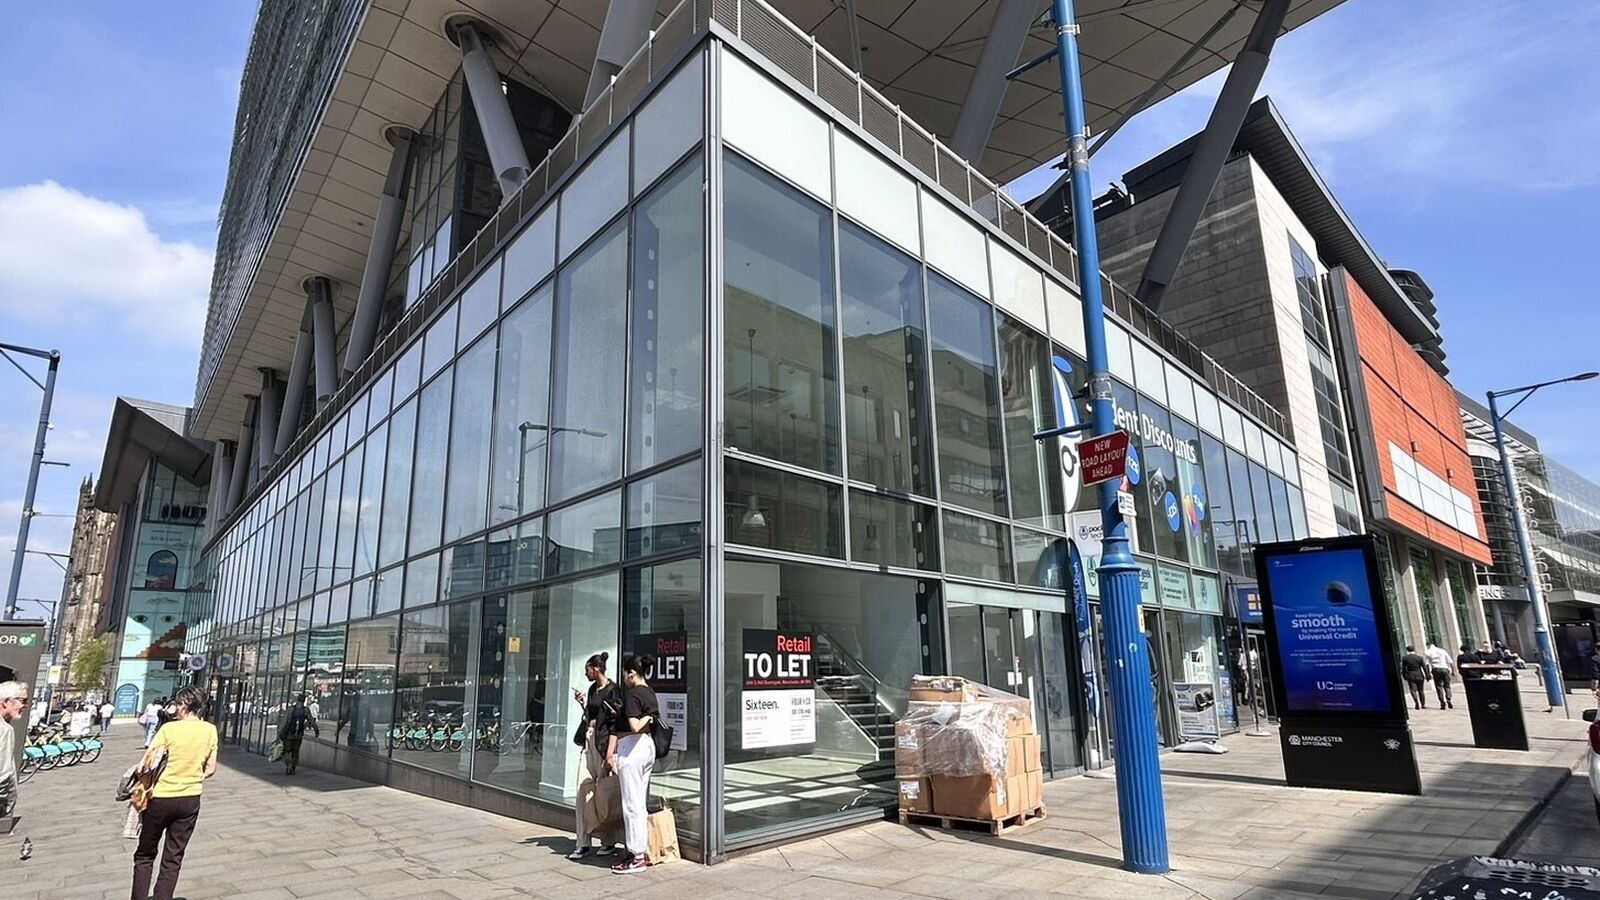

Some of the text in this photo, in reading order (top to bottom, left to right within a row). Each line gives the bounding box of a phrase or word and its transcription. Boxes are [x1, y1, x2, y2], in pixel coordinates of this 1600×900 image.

[1094, 439, 1111, 452] NEW
[1142, 413, 1197, 463] Discounts
[1081, 447, 1126, 469] ROAD LAYOUT
[1092, 464, 1113, 479] AHEAD
[1528, 518, 1553, 594] SPNCER
[1291, 614, 1345, 628] smooth
[777, 635, 811, 652] Retail
[1298, 632, 1357, 640] Universal Credit
[656, 637, 686, 654] Retail
[657, 656, 685, 679] LET
[744, 652, 811, 678] TO LET
[1316, 681, 1334, 690] UC
[745, 699, 780, 710] Sixteen.
[1301, 735, 1344, 743] MANCHESTER
